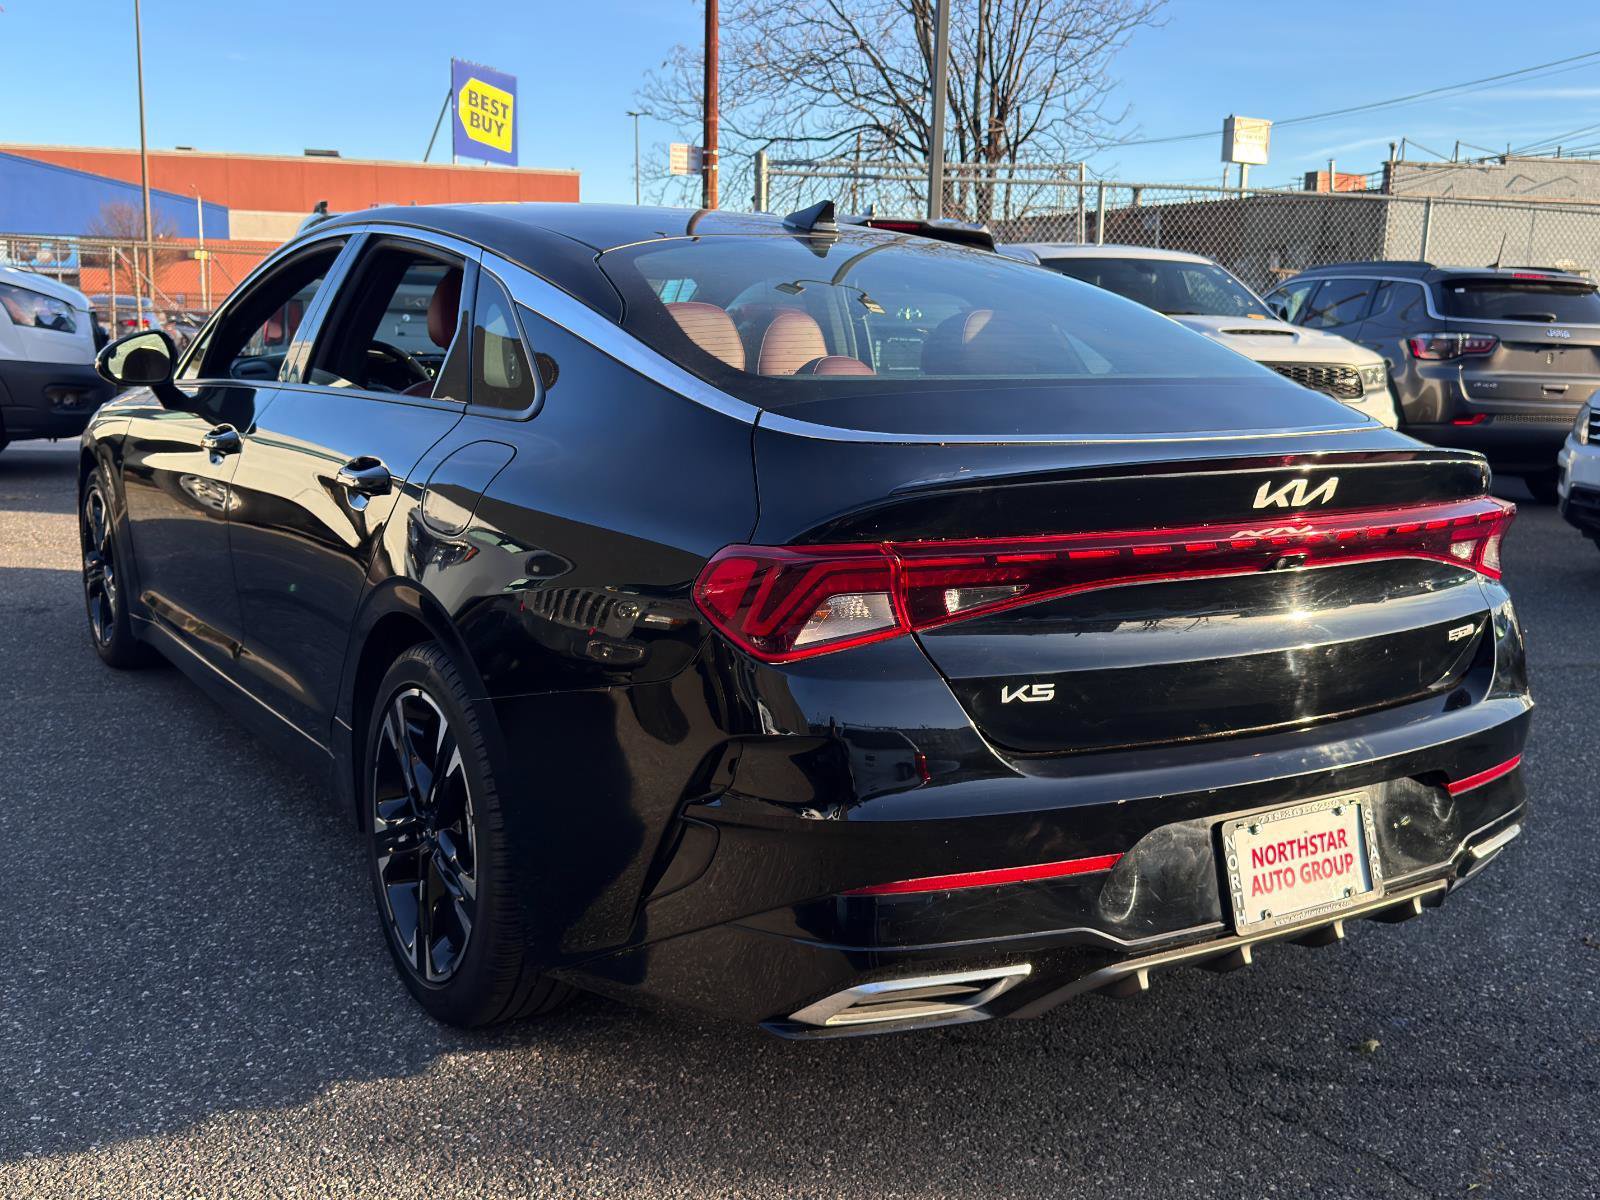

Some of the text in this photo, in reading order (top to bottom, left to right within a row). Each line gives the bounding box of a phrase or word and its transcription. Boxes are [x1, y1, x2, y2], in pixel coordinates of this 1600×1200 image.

[468, 89, 509, 119] BEST
[470, 111, 504, 137] BUY
[1252, 476, 1339, 509] KIA
[1001, 683, 1056, 704] K5
[1251, 828, 1348, 869] NORTHSTAR
[1363, 809, 1383, 880] STAR
[1224, 834, 1247, 927] NORTH
[1251, 853, 1354, 897] AUTO GROUP
